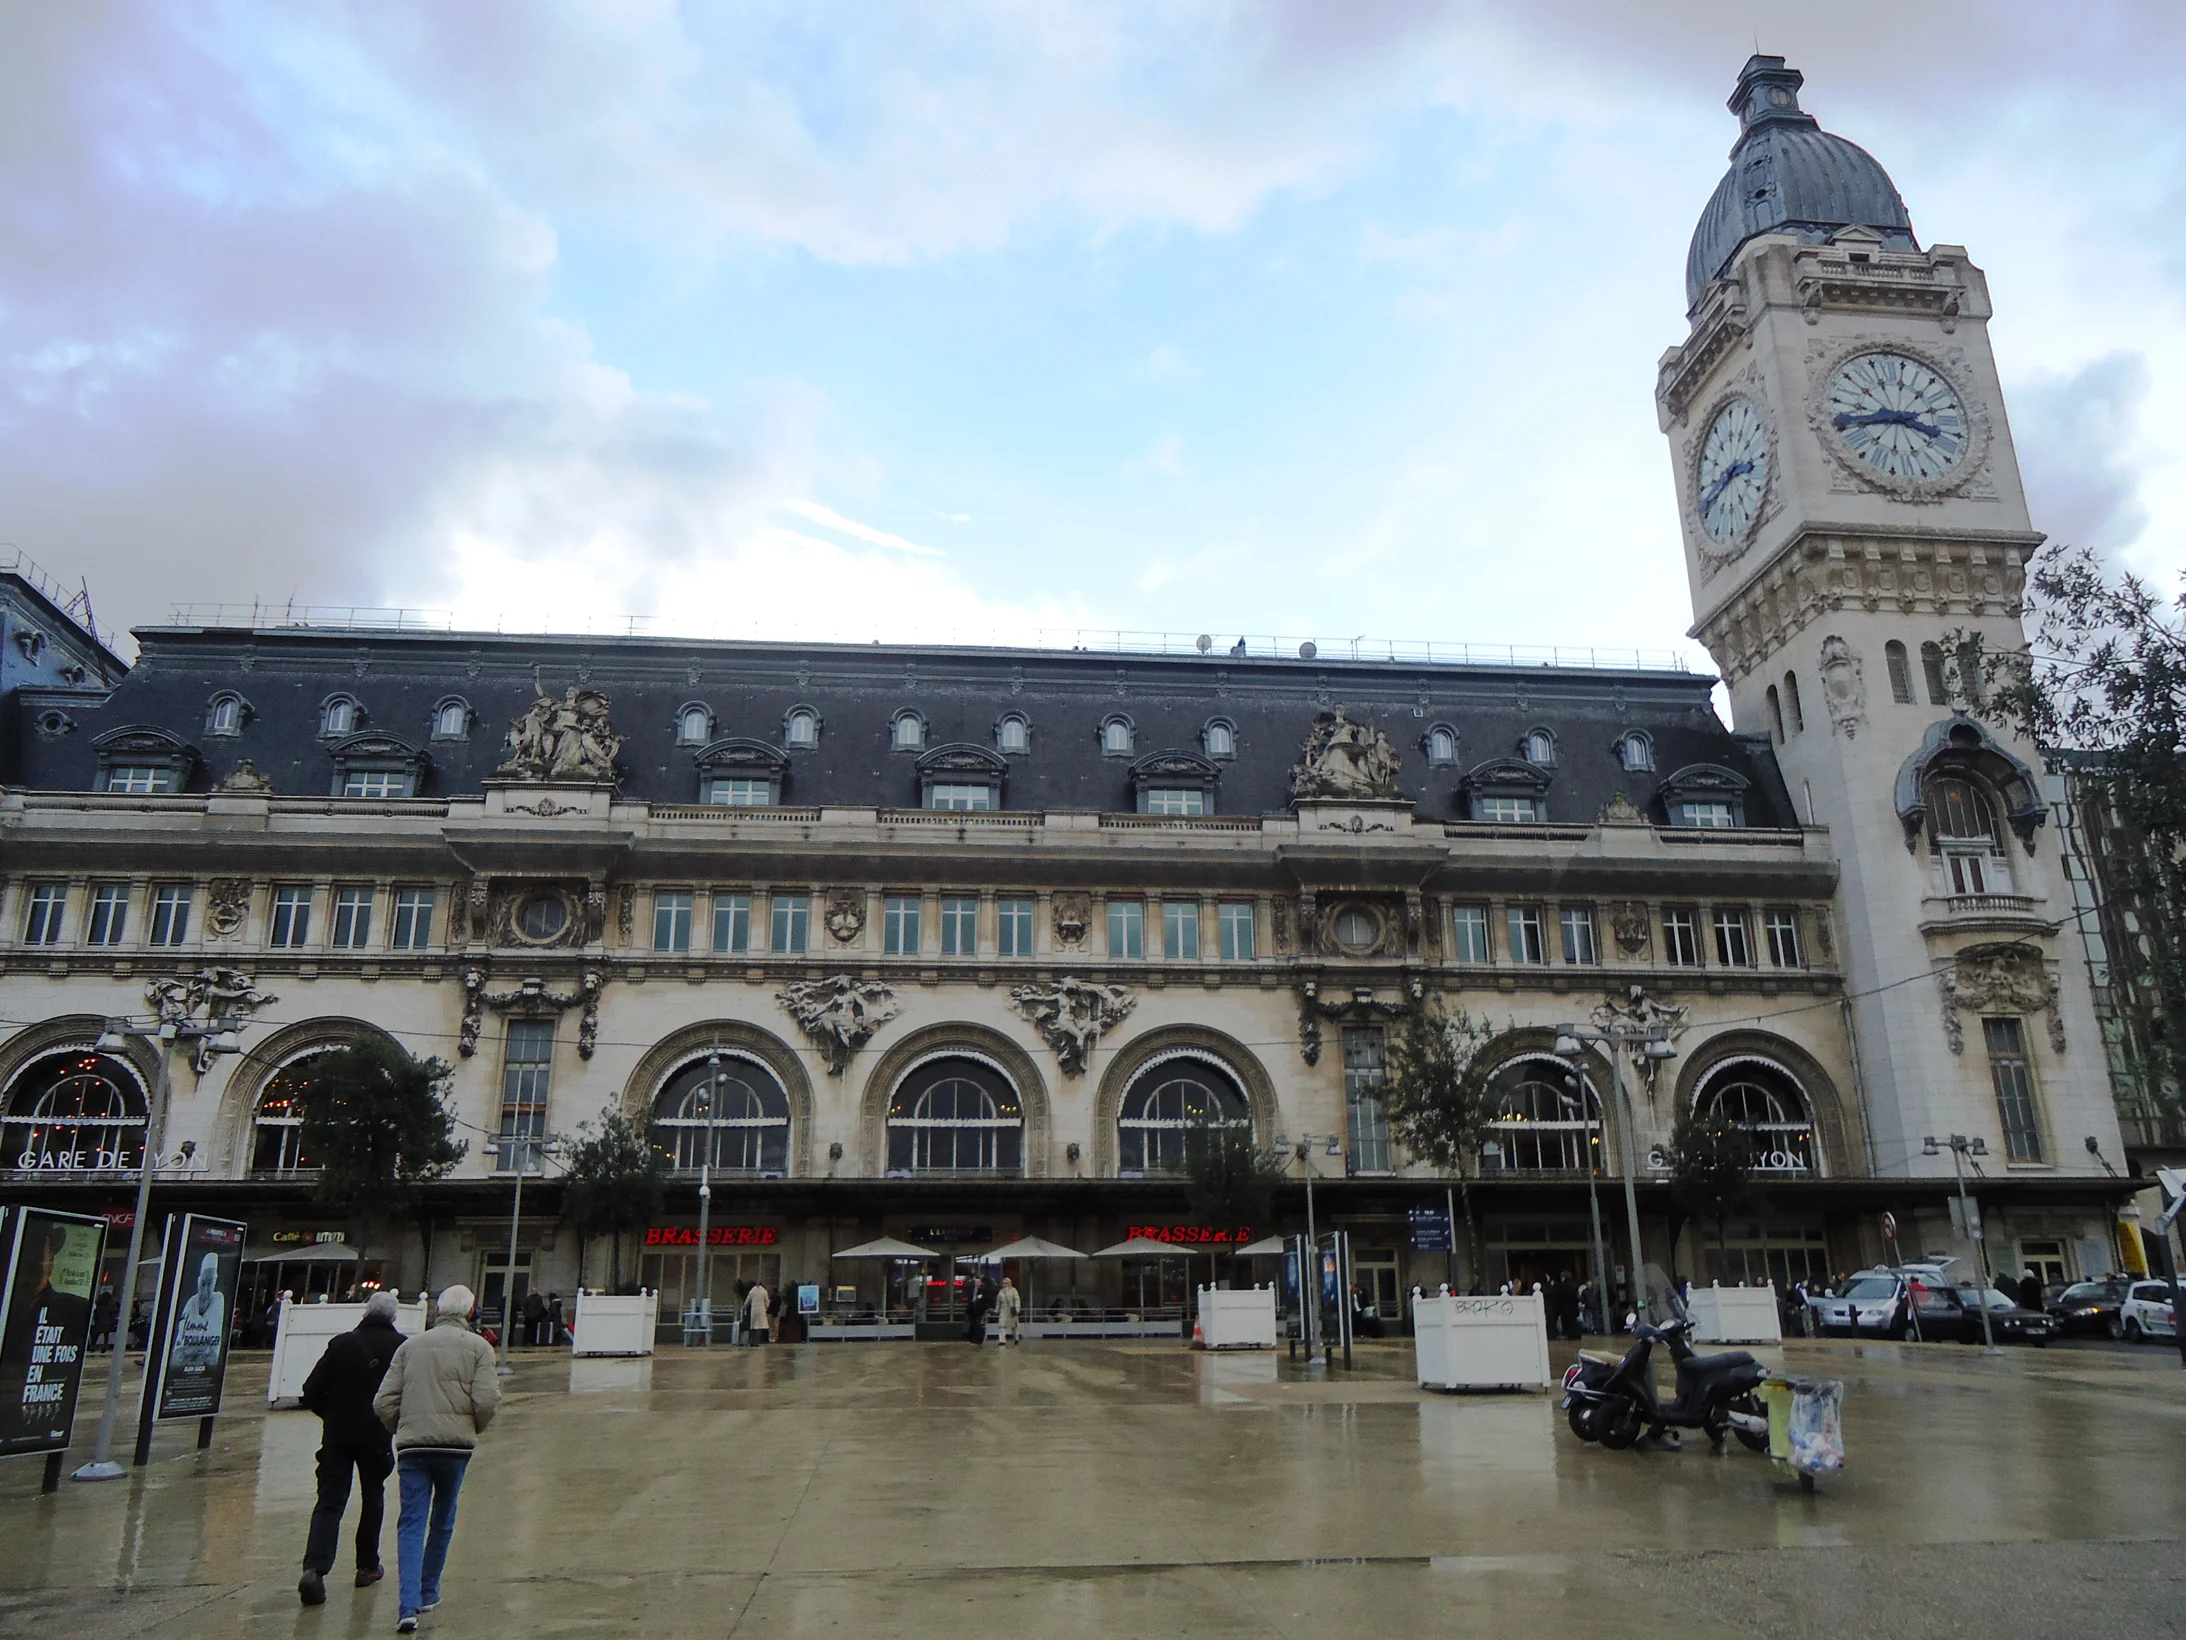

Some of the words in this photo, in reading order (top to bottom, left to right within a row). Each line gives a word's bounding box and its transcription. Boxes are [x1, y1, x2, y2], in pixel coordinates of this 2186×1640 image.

[18, 1151, 88, 1169] GARE
[97, 1151, 131, 1169] DE
[142, 1151, 208, 1169] YON
[38, 1307, 48, 1324] IL
[31, 1345, 53, 1364] UNE
[54, 1345, 79, 1363] FOIS
[26, 1365, 44, 1383] EN
[22, 1384, 64, 1403] FRANCE
